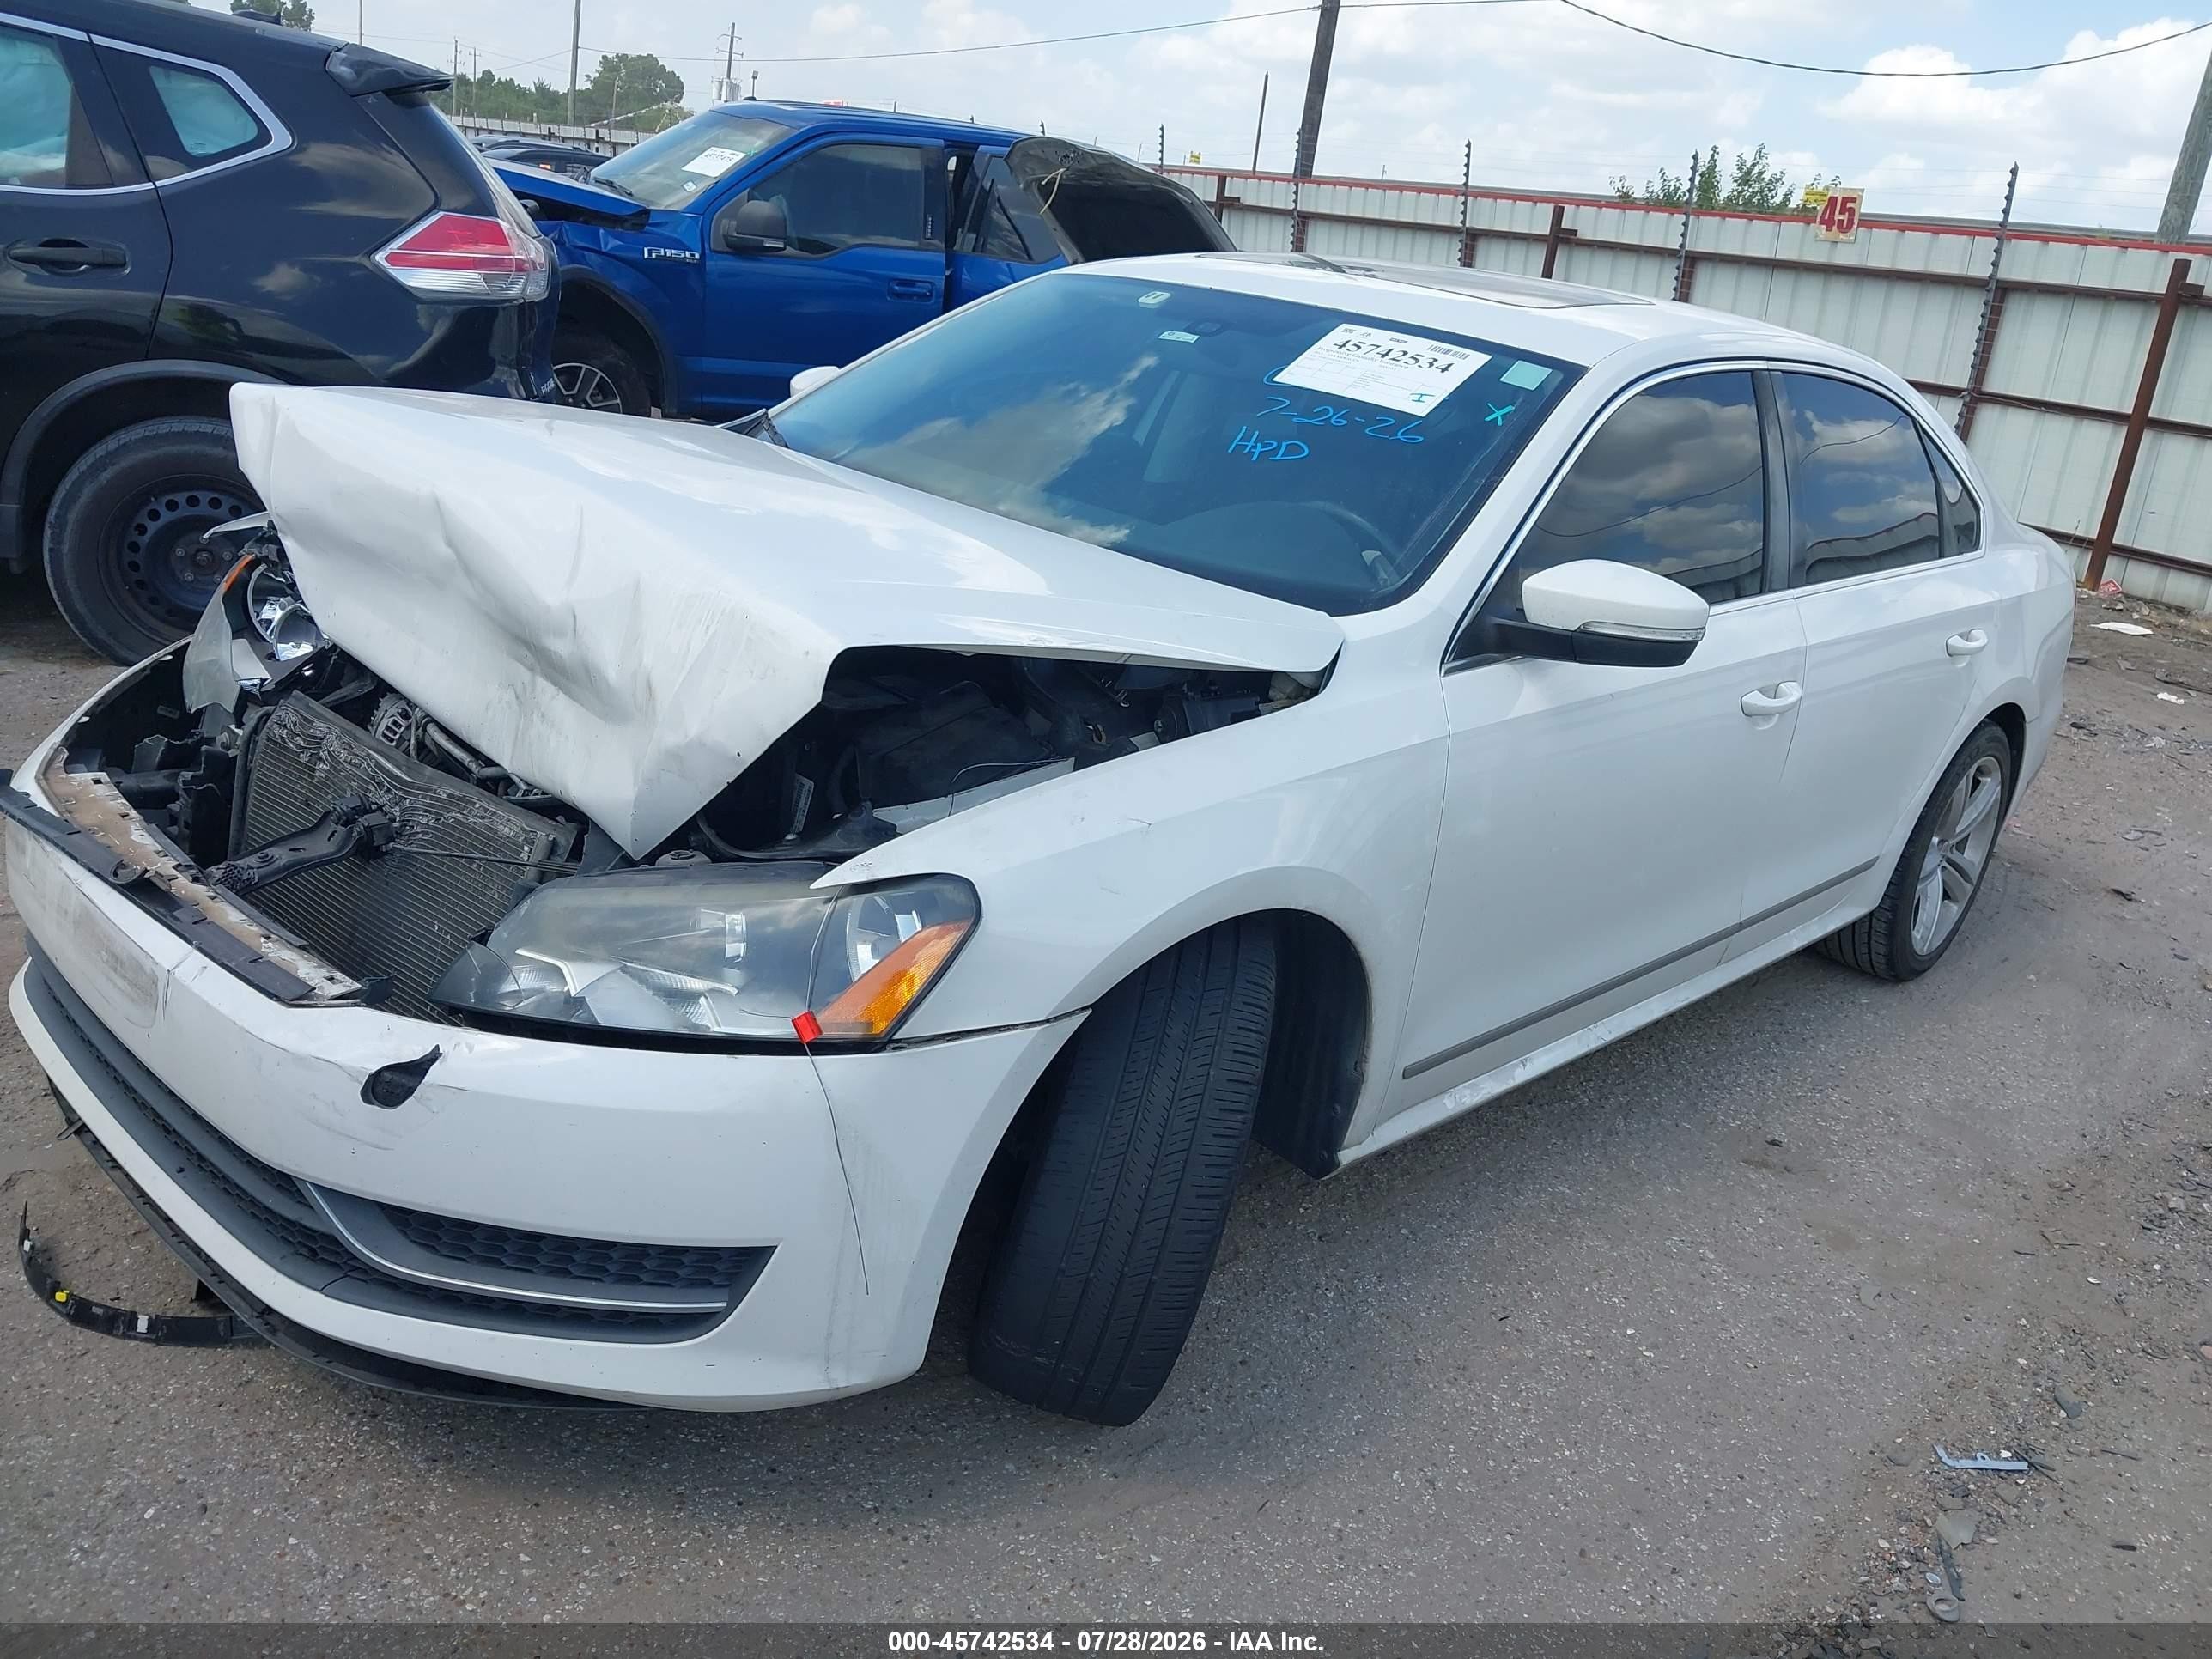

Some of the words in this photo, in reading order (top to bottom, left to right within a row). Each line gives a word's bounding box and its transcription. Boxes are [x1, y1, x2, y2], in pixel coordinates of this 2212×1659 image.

[1819, 196, 1857, 234] 45
[1333, 339, 1455, 374] 45742534
[1256, 396, 1425, 443] 7-26-26
